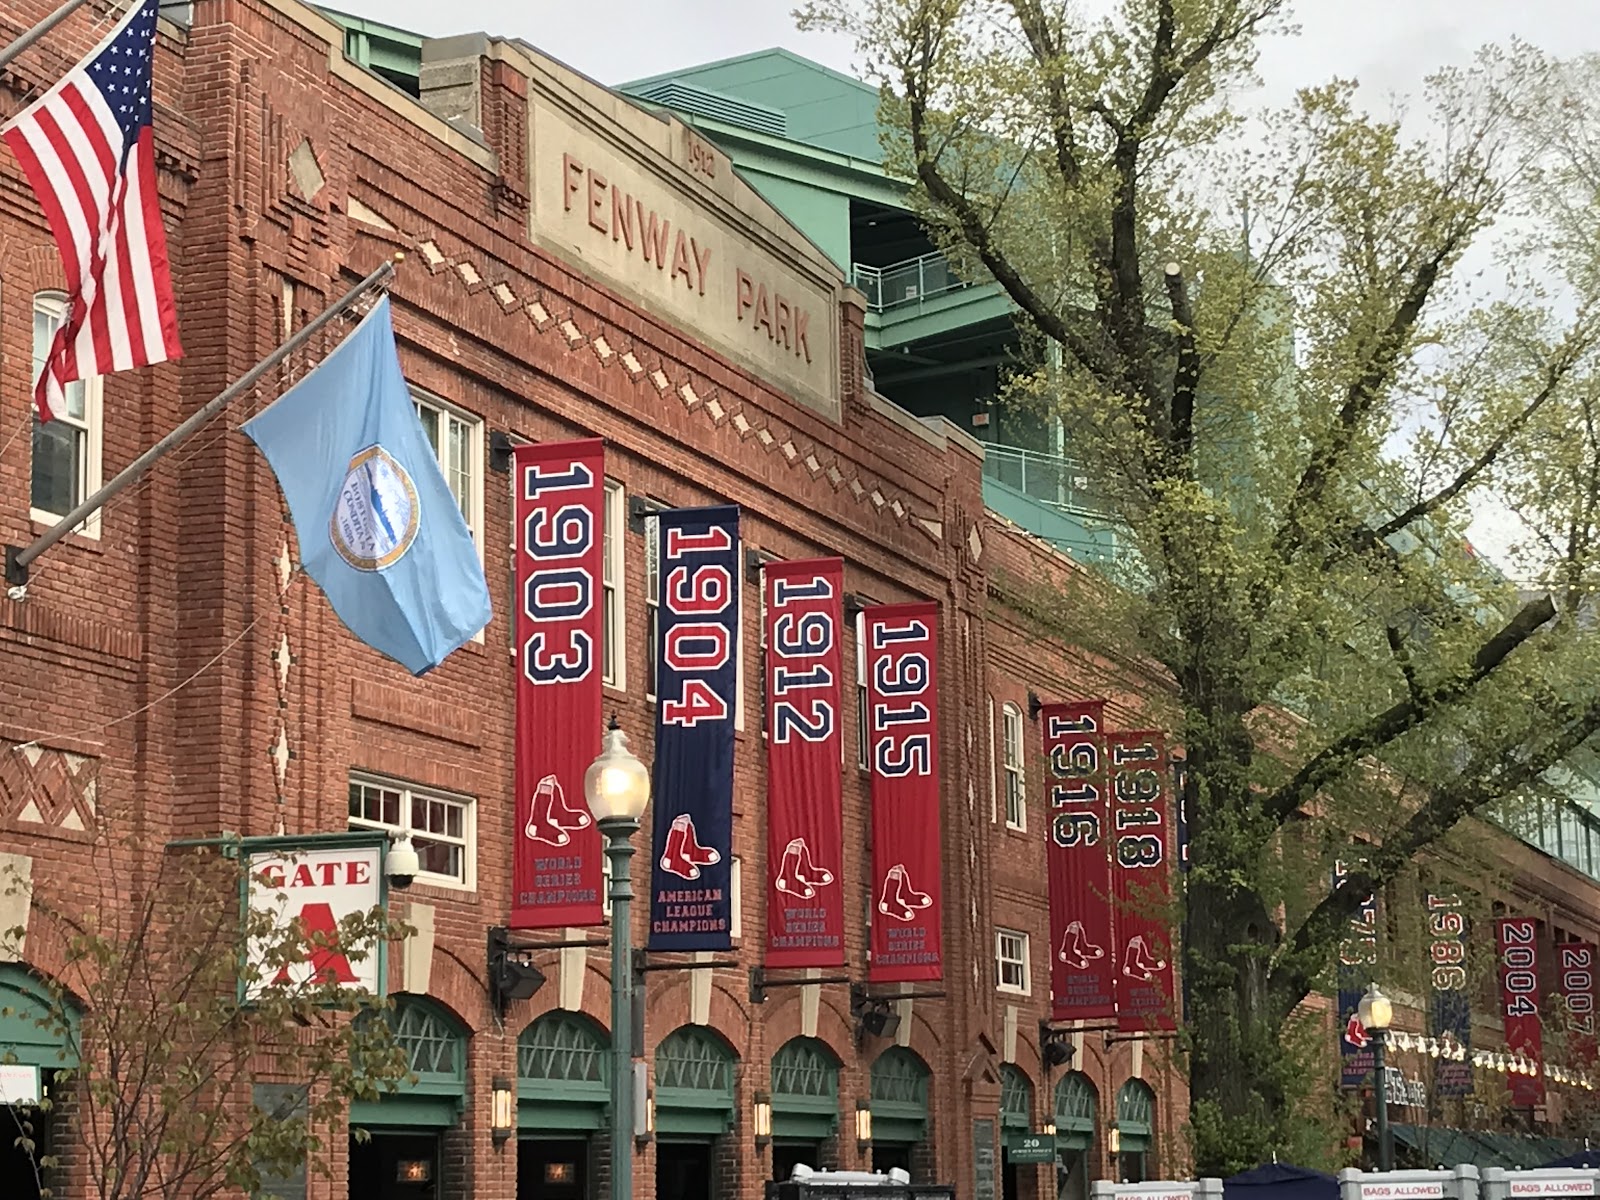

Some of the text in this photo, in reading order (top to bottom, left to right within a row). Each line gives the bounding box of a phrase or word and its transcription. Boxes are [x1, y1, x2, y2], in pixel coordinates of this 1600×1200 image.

[687, 141, 714, 179] 1912
[563, 152, 812, 365] FENWAY PARK
[525, 462, 593, 685] 1903
[662, 526, 731, 727] 1904
[774, 577, 833, 743] 1912
[873, 620, 931, 777] 1915
[1049, 715, 1100, 847] 1916
[1114, 743, 1162, 868] 1918
[534, 856, 582, 871] WORLD
[259, 861, 371, 889] GATE
[534, 872, 582, 887] SERIES
[519, 888, 597, 905] CHAMPIONS
[657, 888, 722, 904] AMERICAN
[666, 904, 713, 918] LEAGUE
[784, 908, 826, 921] WORLD
[653, 918, 726, 933] CHAMPIONS
[785, 921, 826, 934] SERIES
[888, 927, 926, 939] WORLD
[270, 902, 361, 985] A
[772, 935, 839, 948] CHAMPIONS
[1428, 893, 1466, 990] 1986
[875, 952, 939, 965] CHAMPIONS
[1503, 923, 1537, 1016] 2004
[1562, 949, 1594, 1035] 2007
[1023, 1138, 1040, 1148] 20
[1363, 1186, 1442, 1196] BAGS ALLOWED
[1512, 1182, 1593, 1193] BAGS ALLOWED
